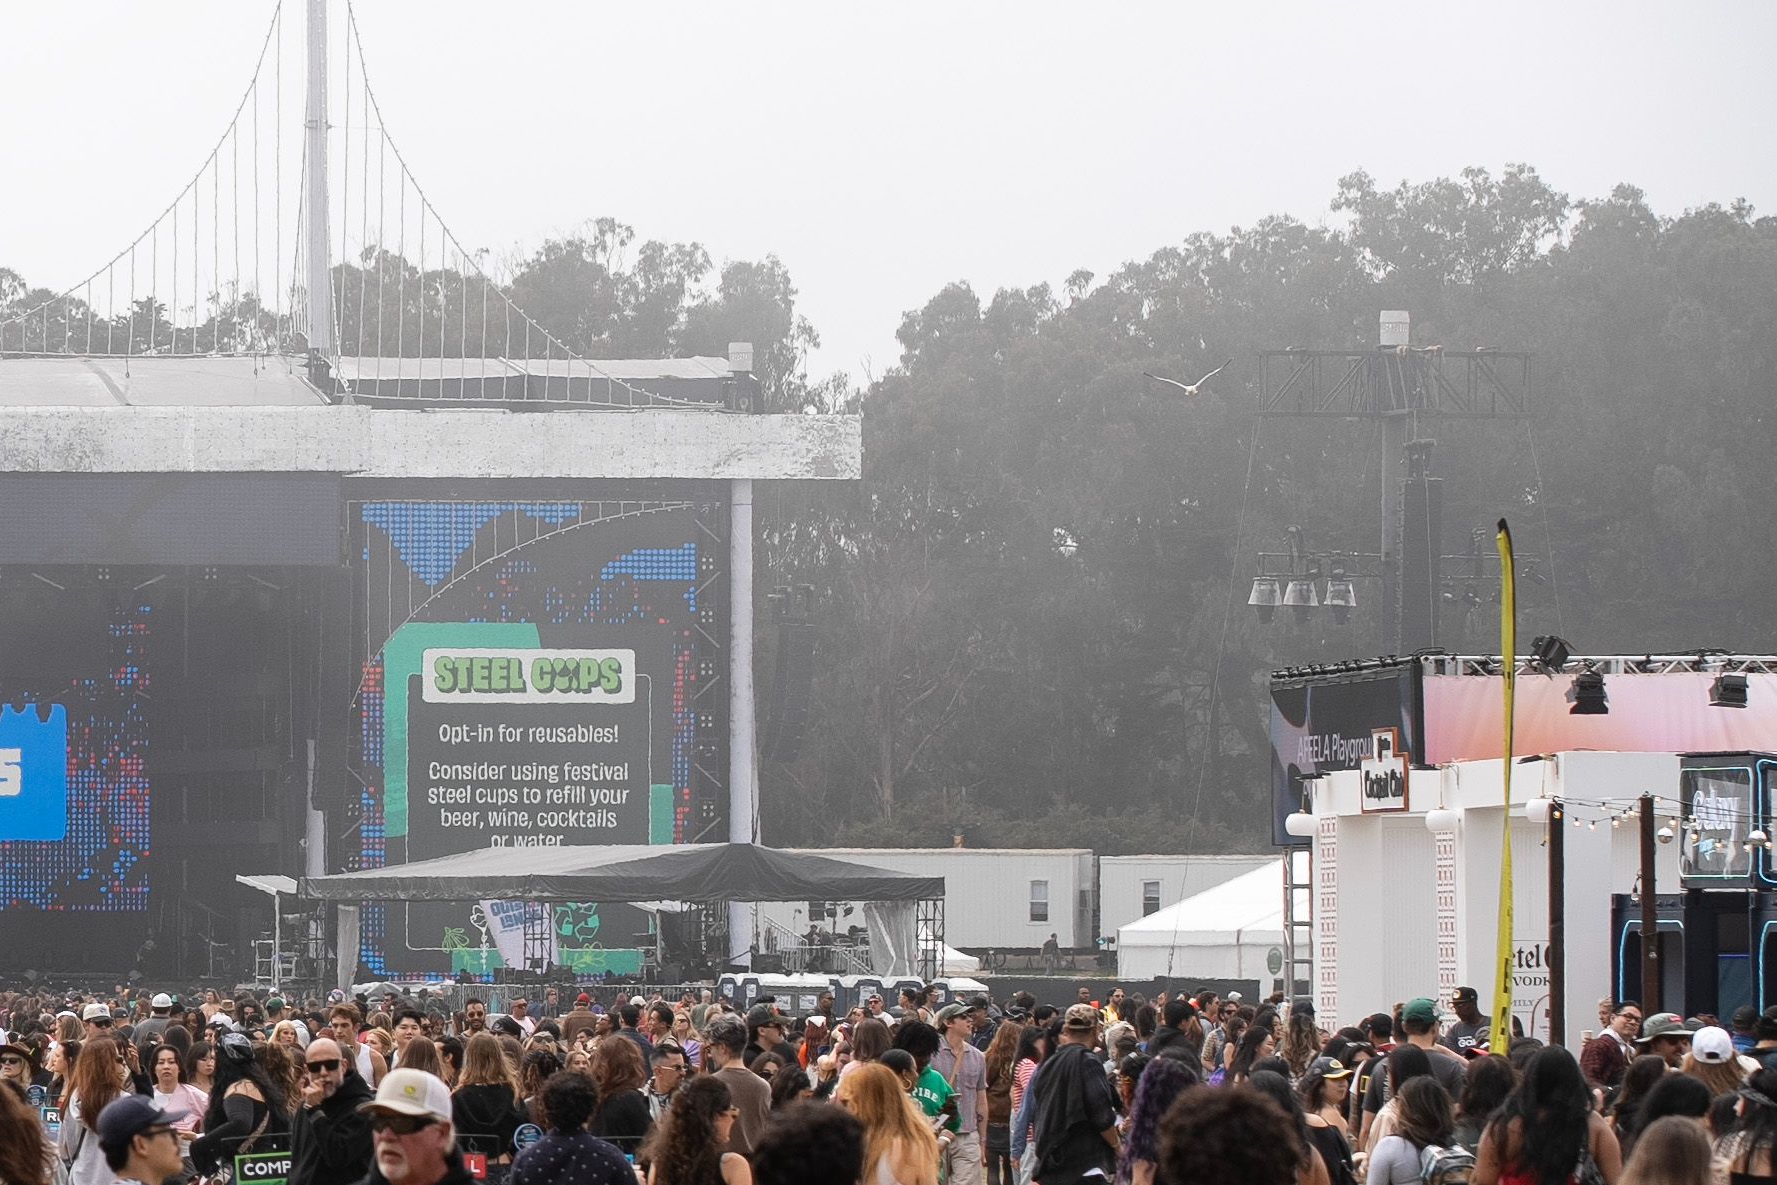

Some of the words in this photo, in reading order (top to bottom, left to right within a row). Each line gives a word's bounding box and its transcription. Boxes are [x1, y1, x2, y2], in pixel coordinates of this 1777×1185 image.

[434, 656, 526, 693] STEEL
[530, 656, 622, 693] CUPS
[439, 724, 493, 745] Opt-in
[498, 724, 524, 743] for
[528, 724, 619, 743] reusables!
[1332, 733, 1373, 767] Playgrou
[428, 762, 507, 781] Consider
[511, 762, 559, 785] using
[563, 761, 629, 780] festival
[427, 785, 471, 804] steel
[475, 787, 518, 809] cups
[522, 787, 541, 804] to
[545, 785, 585, 804] refill
[589, 787, 630, 808] your
[440, 809, 484, 830] beer,
[488, 809, 532, 829] wine,
[536, 809, 617, 828] cocktails
[1512, 976, 1550, 986] VODK
[244, 1160, 291, 1176] COMP
